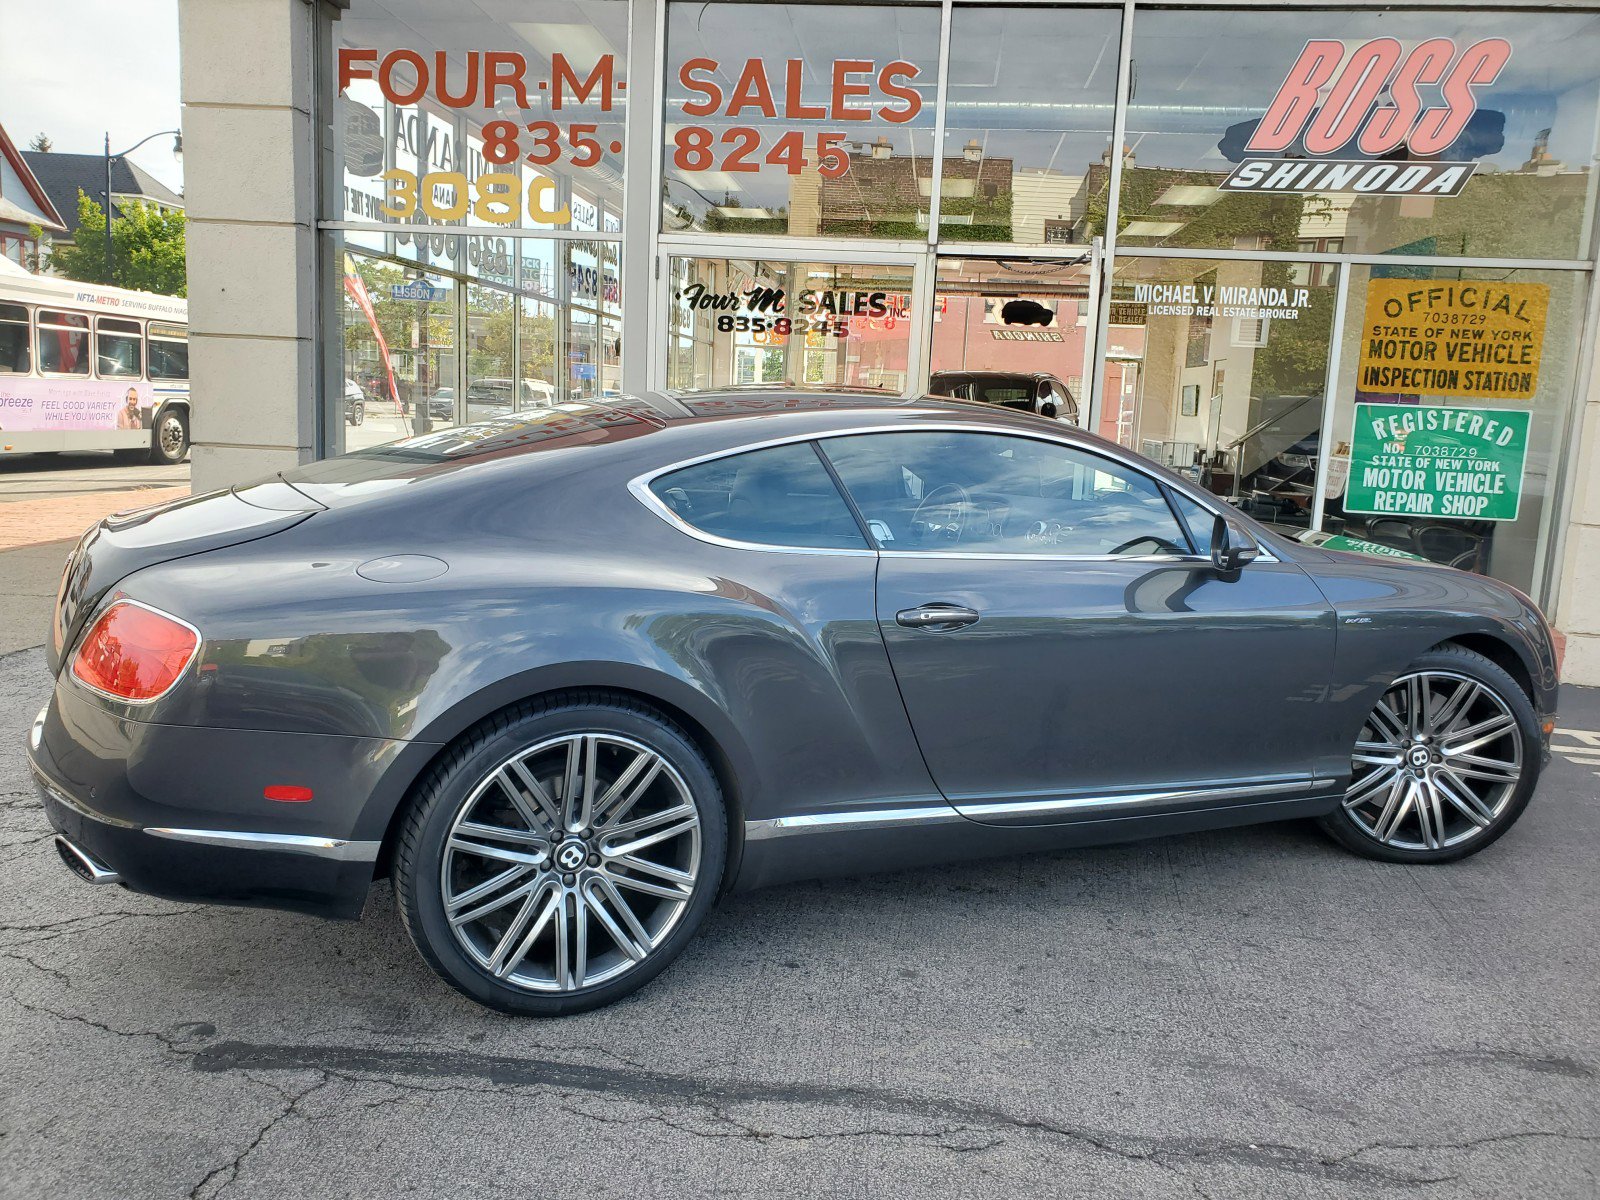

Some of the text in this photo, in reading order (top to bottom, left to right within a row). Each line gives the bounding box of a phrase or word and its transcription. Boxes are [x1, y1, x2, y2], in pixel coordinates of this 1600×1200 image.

[678, 57, 923, 124] SALES
[1244, 37, 1513, 156] BOSS
[673, 126, 851, 178] 8245
[1228, 162, 1468, 193] SHINODA
[394, 285, 430, 300] LISBON
[799, 289, 887, 317] SALES
[890, 308, 909, 318] INC.
[1134, 284, 1312, 308] MICHAEL V. MIRANDA JR.
[1384, 287, 1531, 323] OFFICIAL
[121, 299, 147, 311] SERVING
[147, 305, 173, 314] BUFFALO
[1148, 305, 1193, 316] LICENSED
[1196, 307, 1220, 317] REAL
[1223, 307, 1258, 318] ESTATE
[1259, 309, 1299, 319] BROKER
[1423, 312, 1486, 325] 7038729
[1372, 325, 1533, 342] STATE OF NEW YORK
[1368, 339, 1534, 365] MOTOR VEHICLE
[1363, 366, 1532, 392] INSPECTION STATION
[41, 400, 117, 411] FEEL GOOD VARIETY
[45, 412, 113, 421] WHILE YOU WORK!
[1371, 410, 1514, 447] REGISTERED
[1372, 456, 1500, 472] STATE OF NEW YORK
[1414, 445, 1478, 458] 7038729
[1363, 468, 1427, 490] MOTOR
[1435, 472, 1506, 494] VEHICLE
[1374, 491, 1488, 516] REPAIR SHOP
